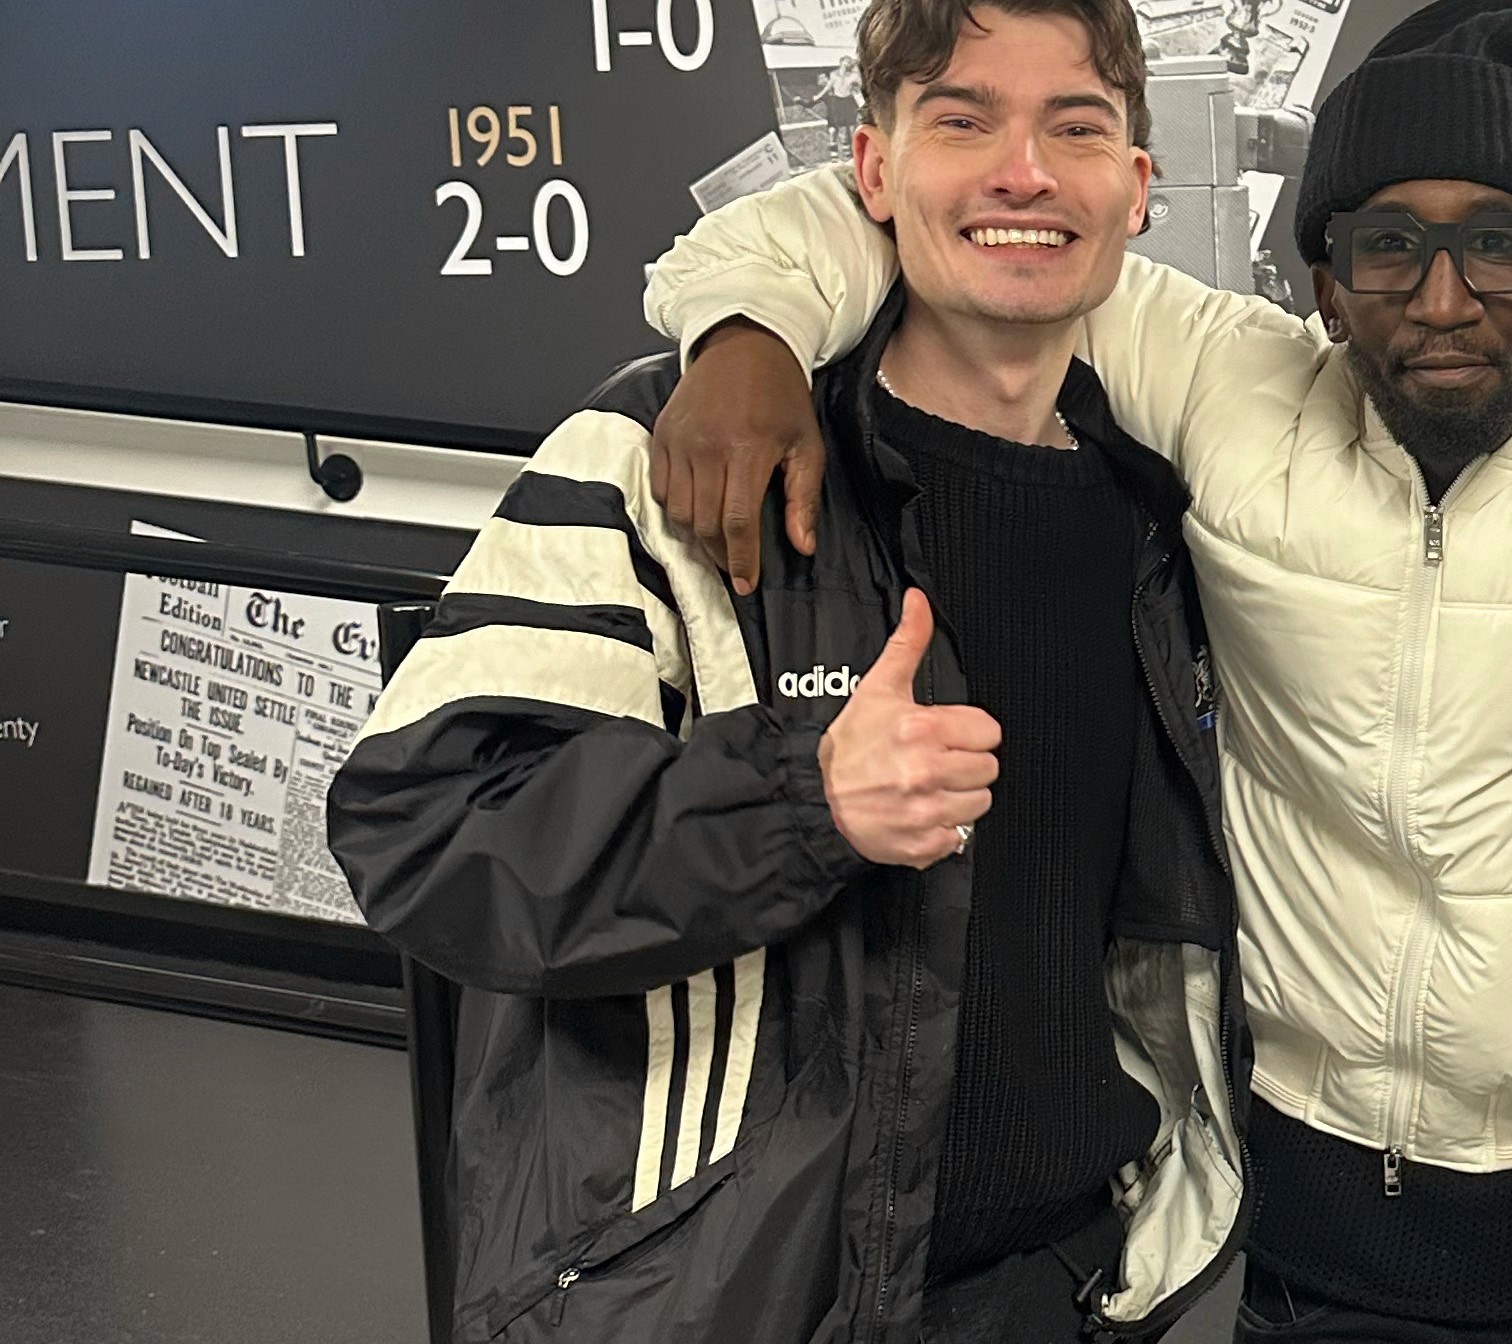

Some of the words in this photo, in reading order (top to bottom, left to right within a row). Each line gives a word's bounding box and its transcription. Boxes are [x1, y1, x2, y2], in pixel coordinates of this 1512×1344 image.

[449, 106, 562, 167] 1951
[436, 178, 589, 276] 2-0
[158, 592, 222, 631] Edition
[246, 592, 305, 639] The
[134, 658, 201, 696] NEWCASTLE
[207, 679, 248, 710] UNITED
[254, 696, 296, 725] SETTLE
[161, 629, 283, 687] CONGRATULATIONS
[297, 671, 315, 697] TO
[329, 681, 353, 709] THE
[181, 697, 201, 721] THE
[179, 788, 212, 812] AFTER
